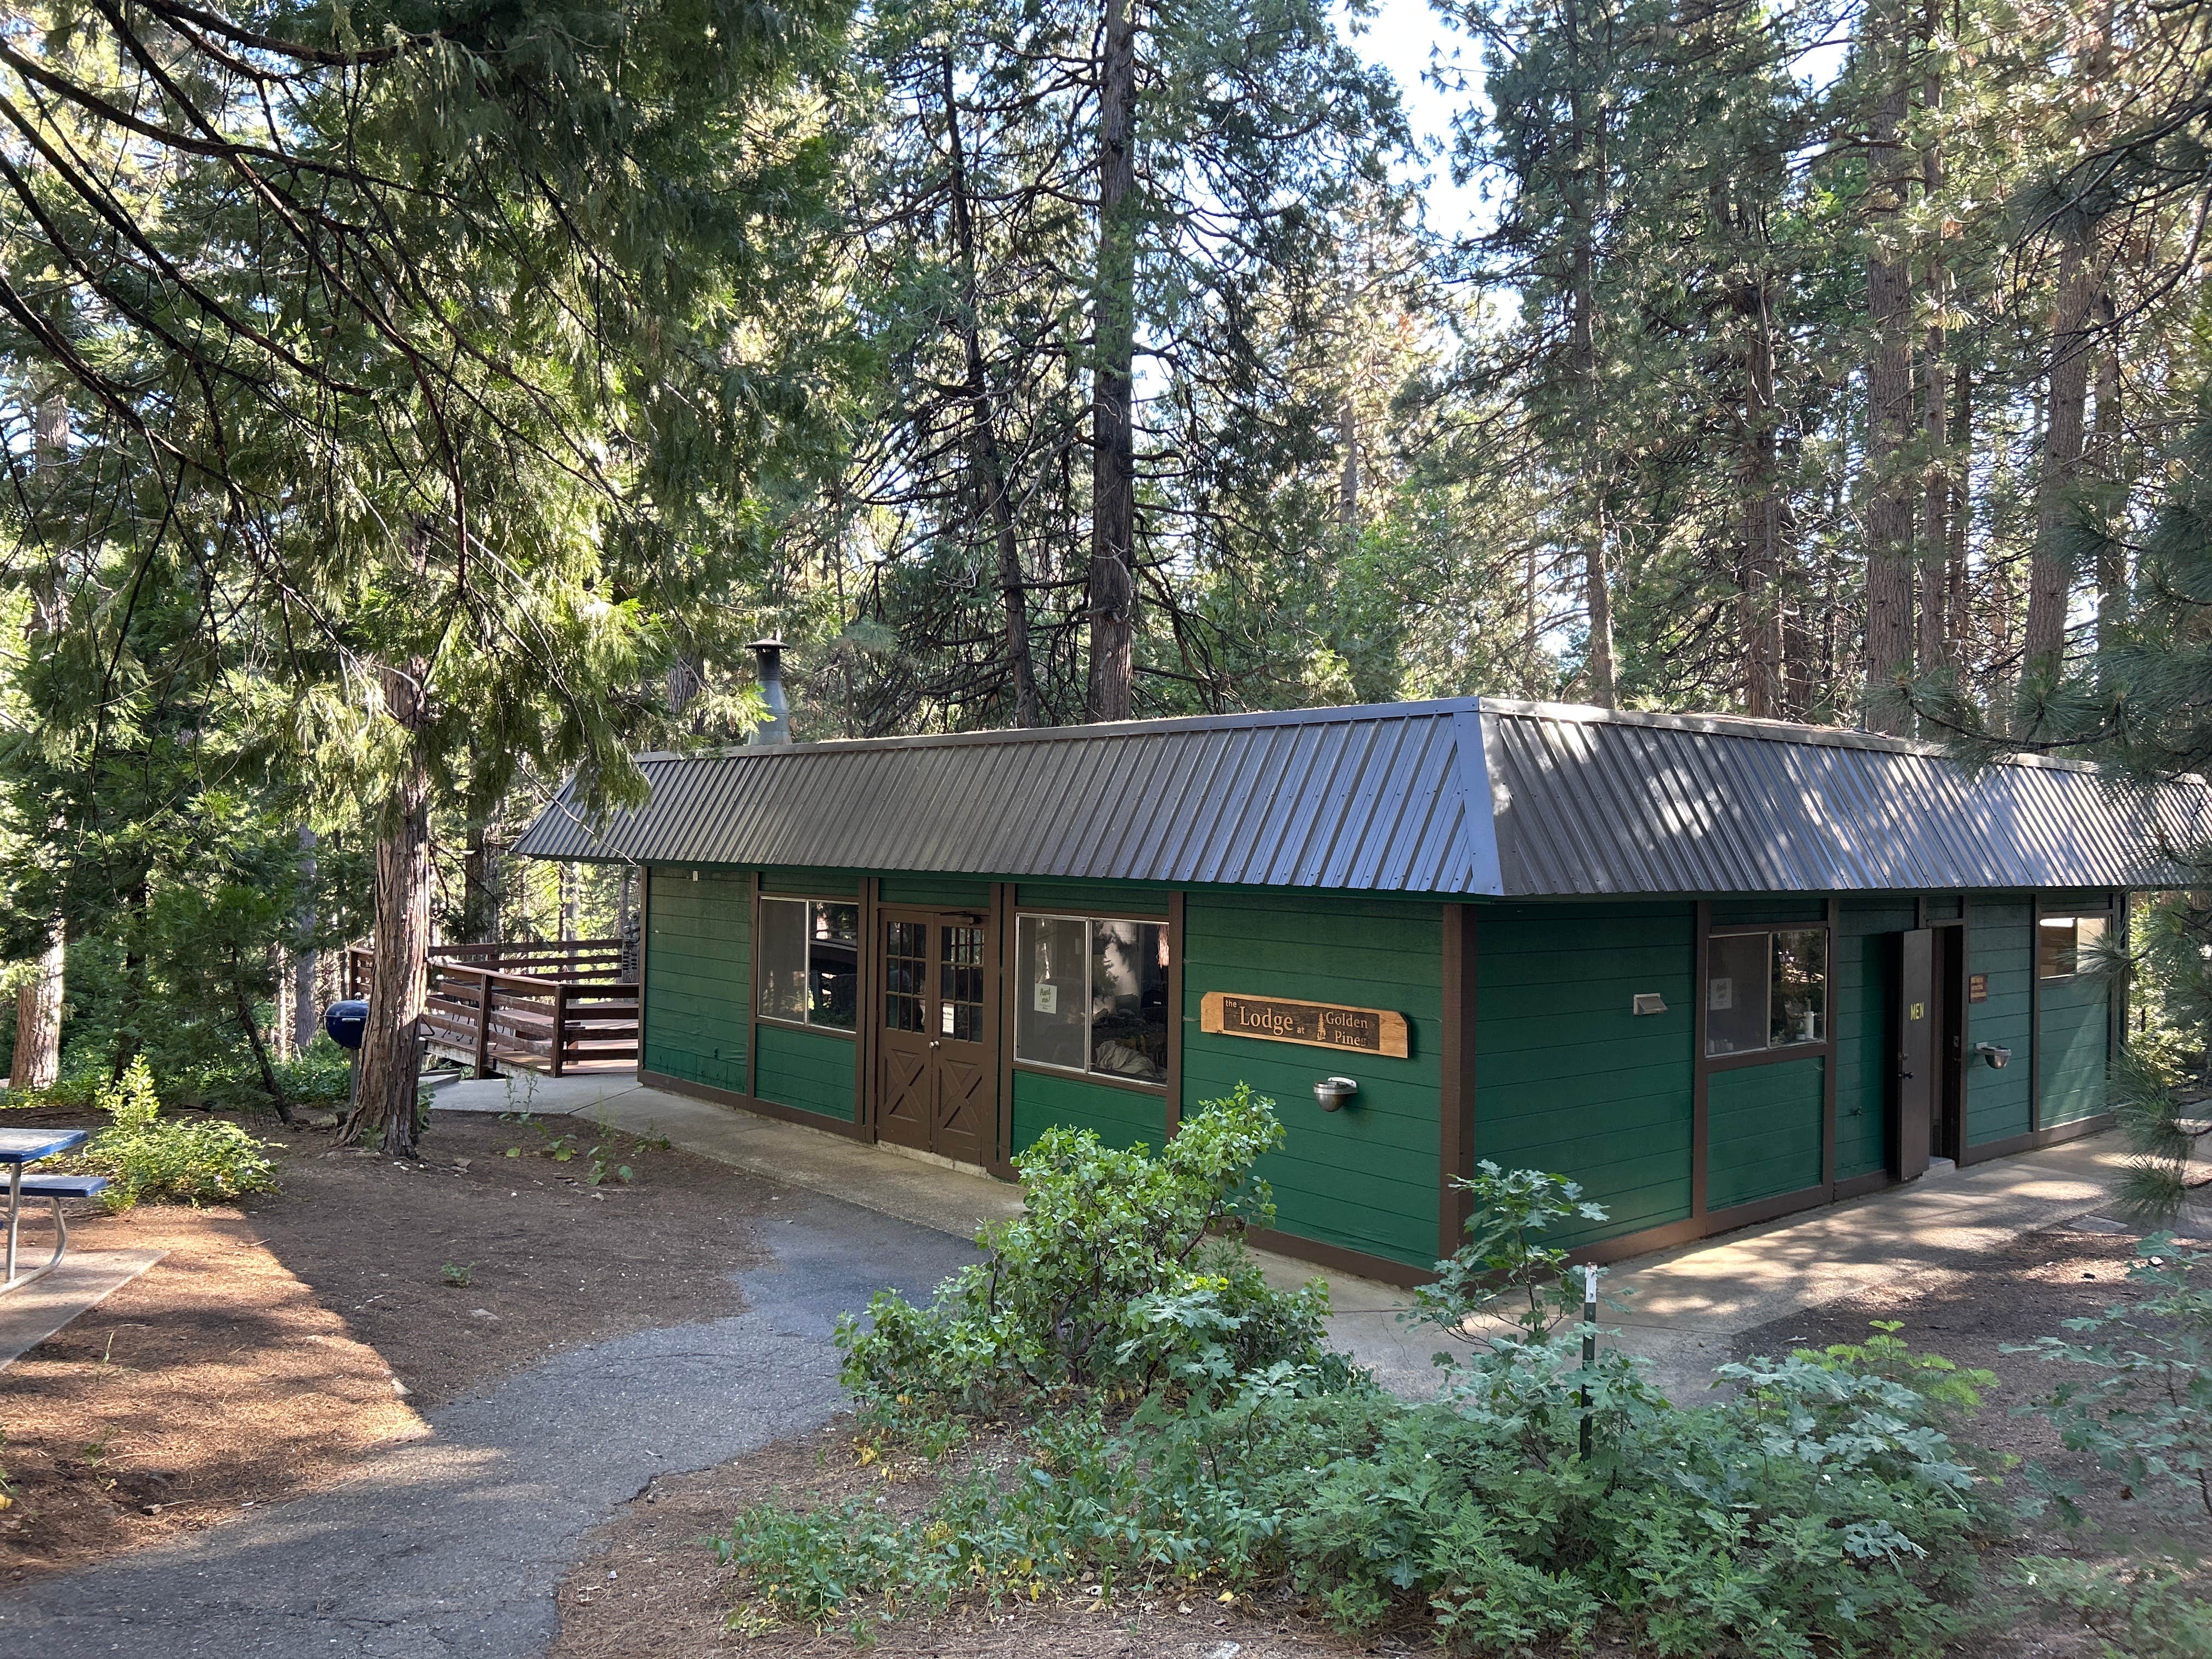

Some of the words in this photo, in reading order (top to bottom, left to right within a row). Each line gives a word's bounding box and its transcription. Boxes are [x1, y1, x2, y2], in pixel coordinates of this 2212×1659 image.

[1225, 999, 1237, 1008] the
[1239, 1006, 1294, 1036] Lodge
[1325, 1012, 1368, 1029] Golden
[1910, 1001, 1925, 1021] MEN
